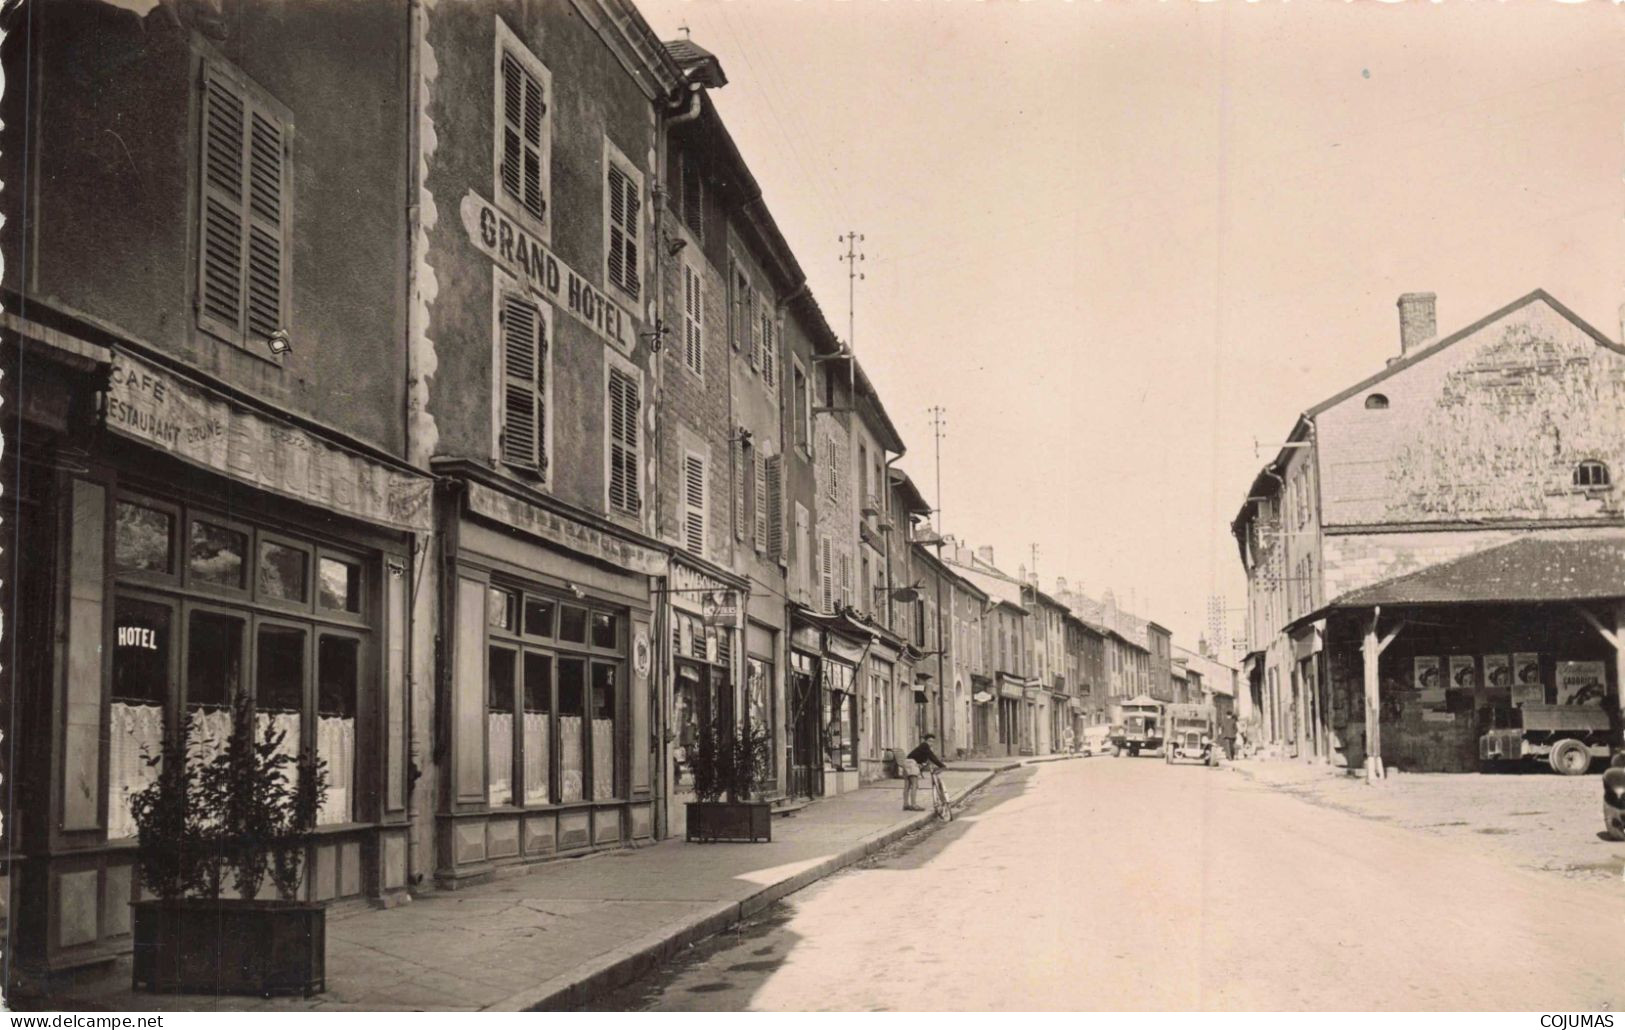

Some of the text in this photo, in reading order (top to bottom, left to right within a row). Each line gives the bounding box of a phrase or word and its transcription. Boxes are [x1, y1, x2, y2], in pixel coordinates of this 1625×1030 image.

[480, 206, 627, 346] GRAND HOTEL
[108, 397, 181, 445] ESTAURANT
[118, 626, 157, 649] HOTEL
